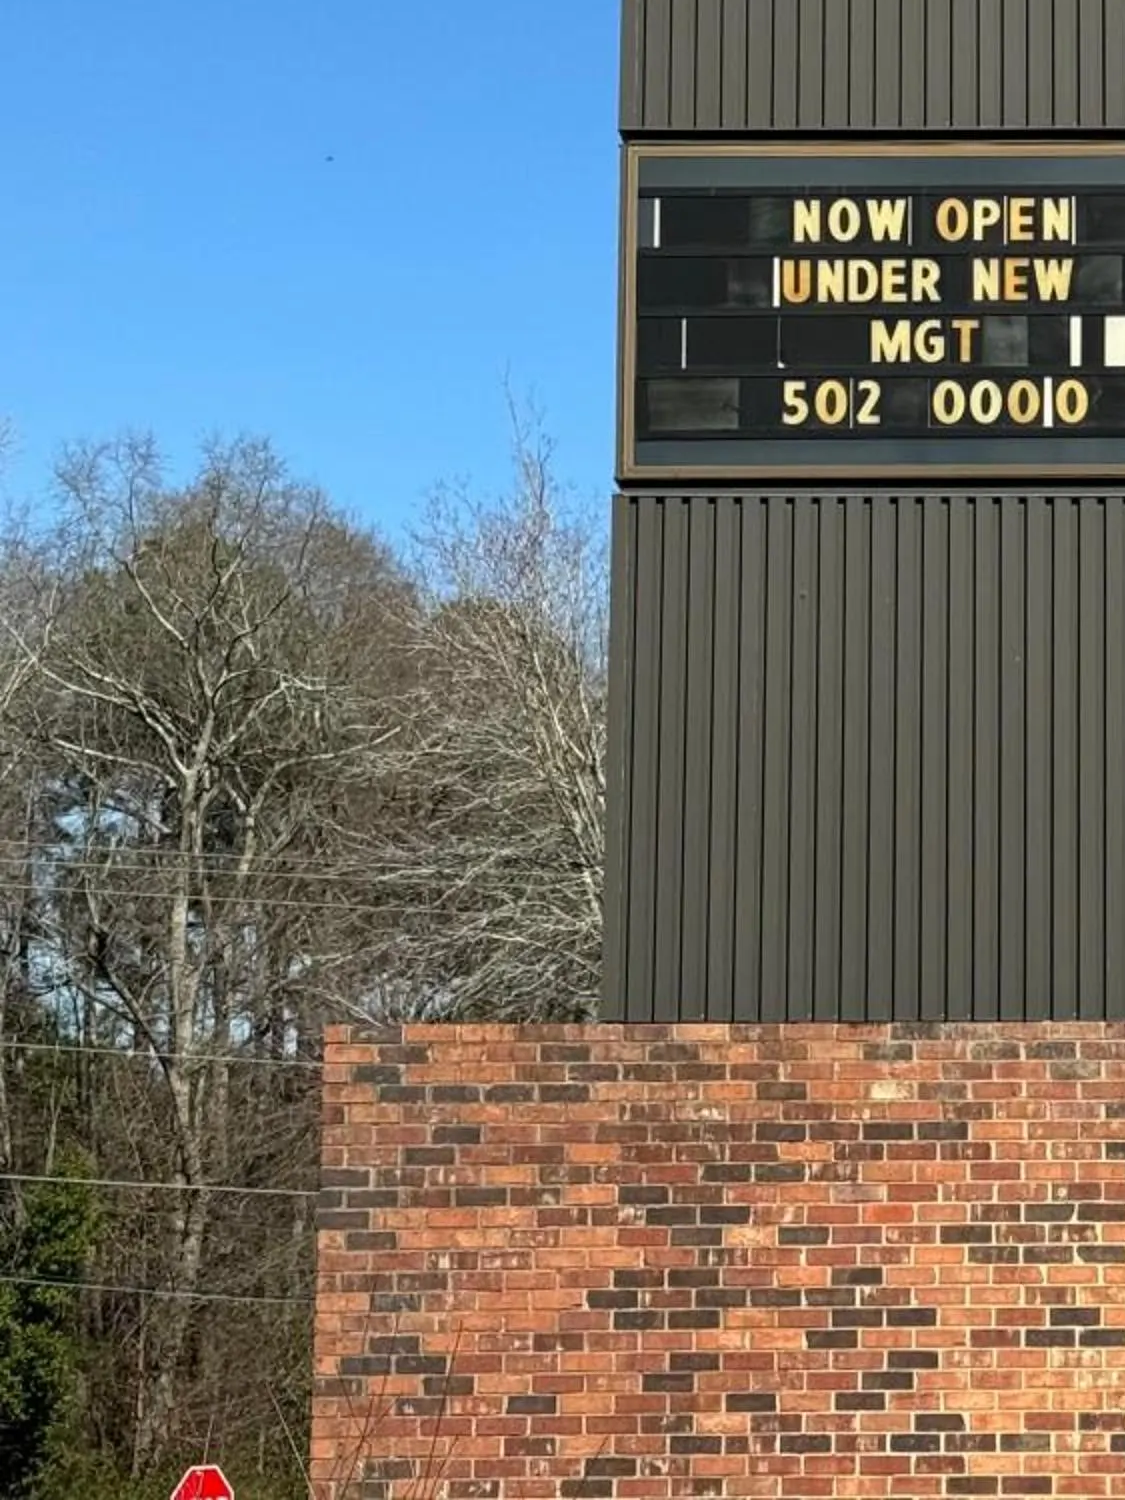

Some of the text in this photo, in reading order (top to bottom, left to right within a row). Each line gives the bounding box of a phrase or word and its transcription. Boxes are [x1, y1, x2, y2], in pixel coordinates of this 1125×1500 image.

[792, 197, 1071, 244] NOW OPEN
[782, 257, 1074, 304] UNDER NEW
[870, 318, 980, 364] MGT
[781, 378, 882, 426] 502
